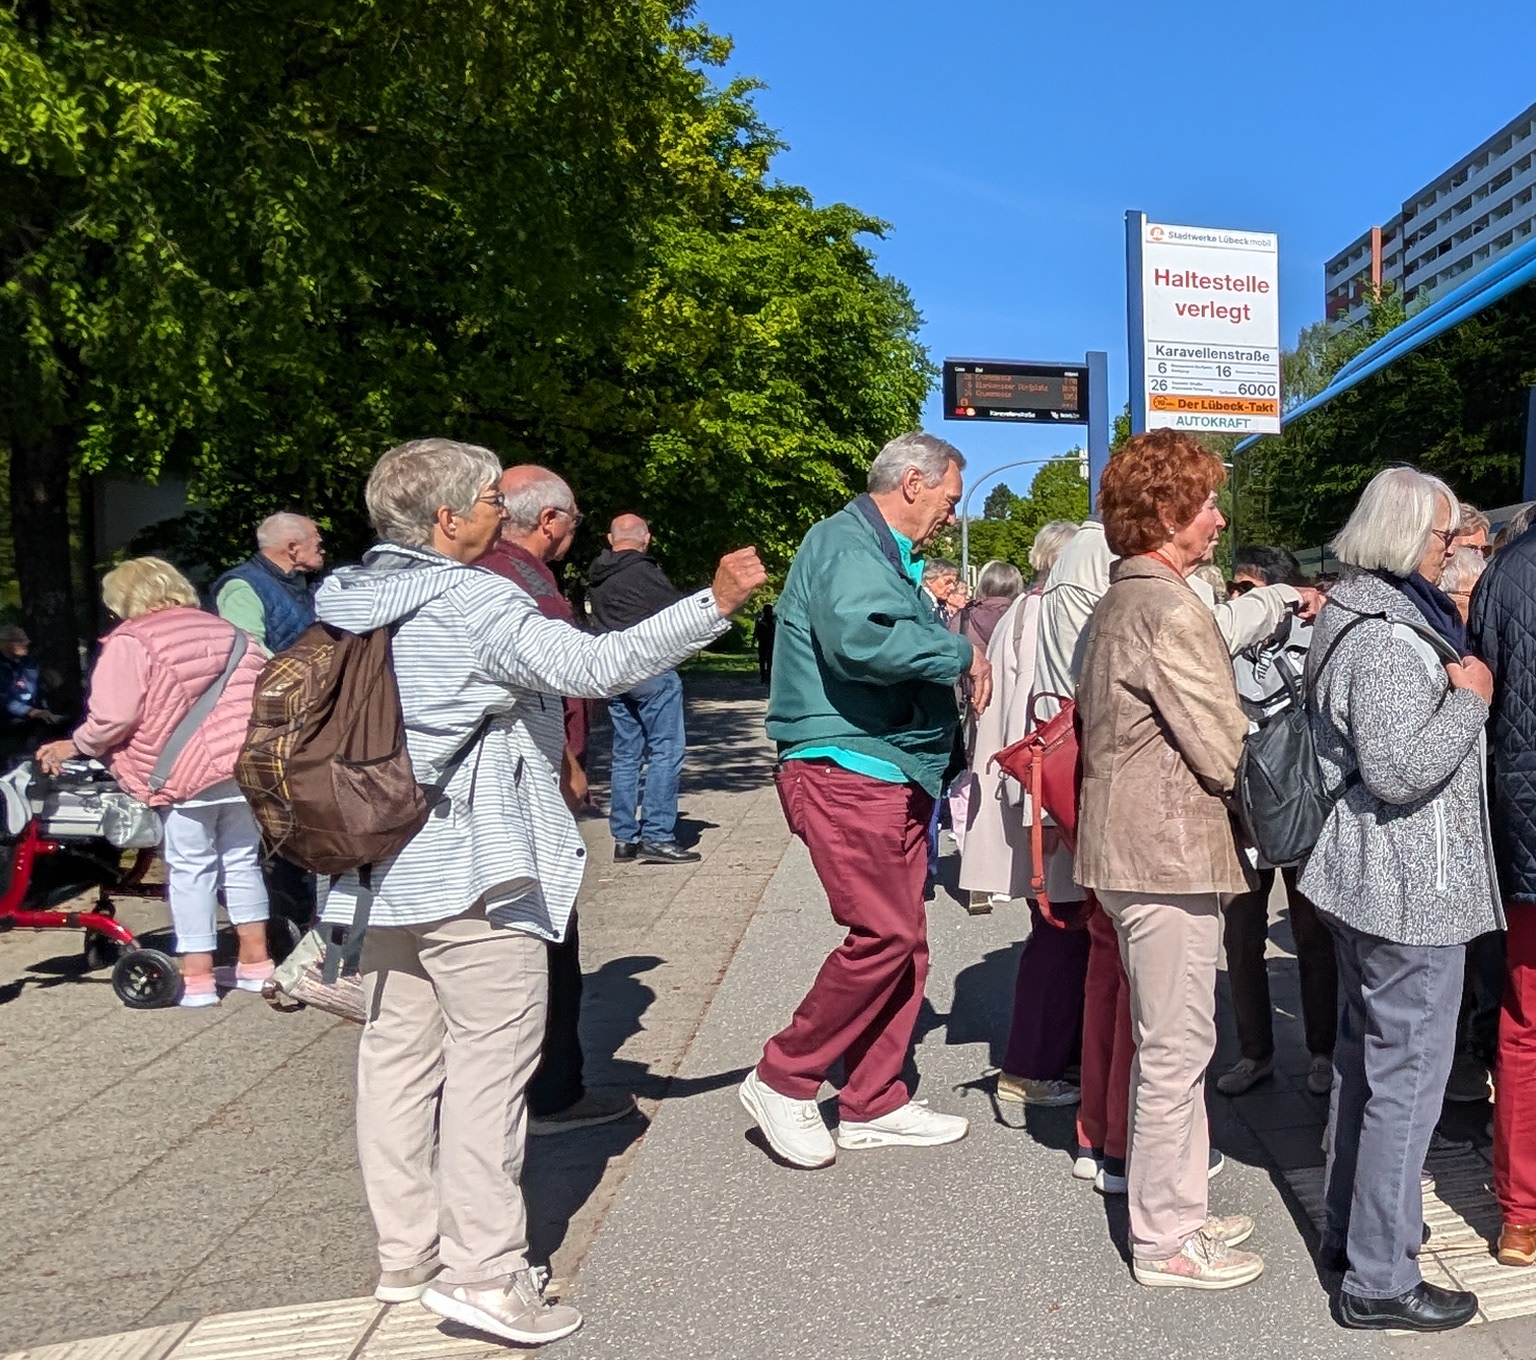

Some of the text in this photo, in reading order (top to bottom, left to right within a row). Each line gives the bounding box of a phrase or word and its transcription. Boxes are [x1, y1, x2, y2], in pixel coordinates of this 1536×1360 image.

[1168, 231, 1217, 242] Stadtwerke
[1155, 268, 1270, 294] Haltestelle
[1175, 301, 1251, 324] verlegt
[1156, 345, 1270, 362] Karavellenstraße
[1158, 362, 1167, 374] 6
[1216, 365, 1232, 378] 16
[1151, 379, 1168, 392] 26
[1238, 383, 1276, 397] 6000
[1178, 399, 1199, 409] Der
[1201, 400, 1274, 413] Lübeck-Takt
[1176, 416, 1251, 428] AUTOKRAFT
